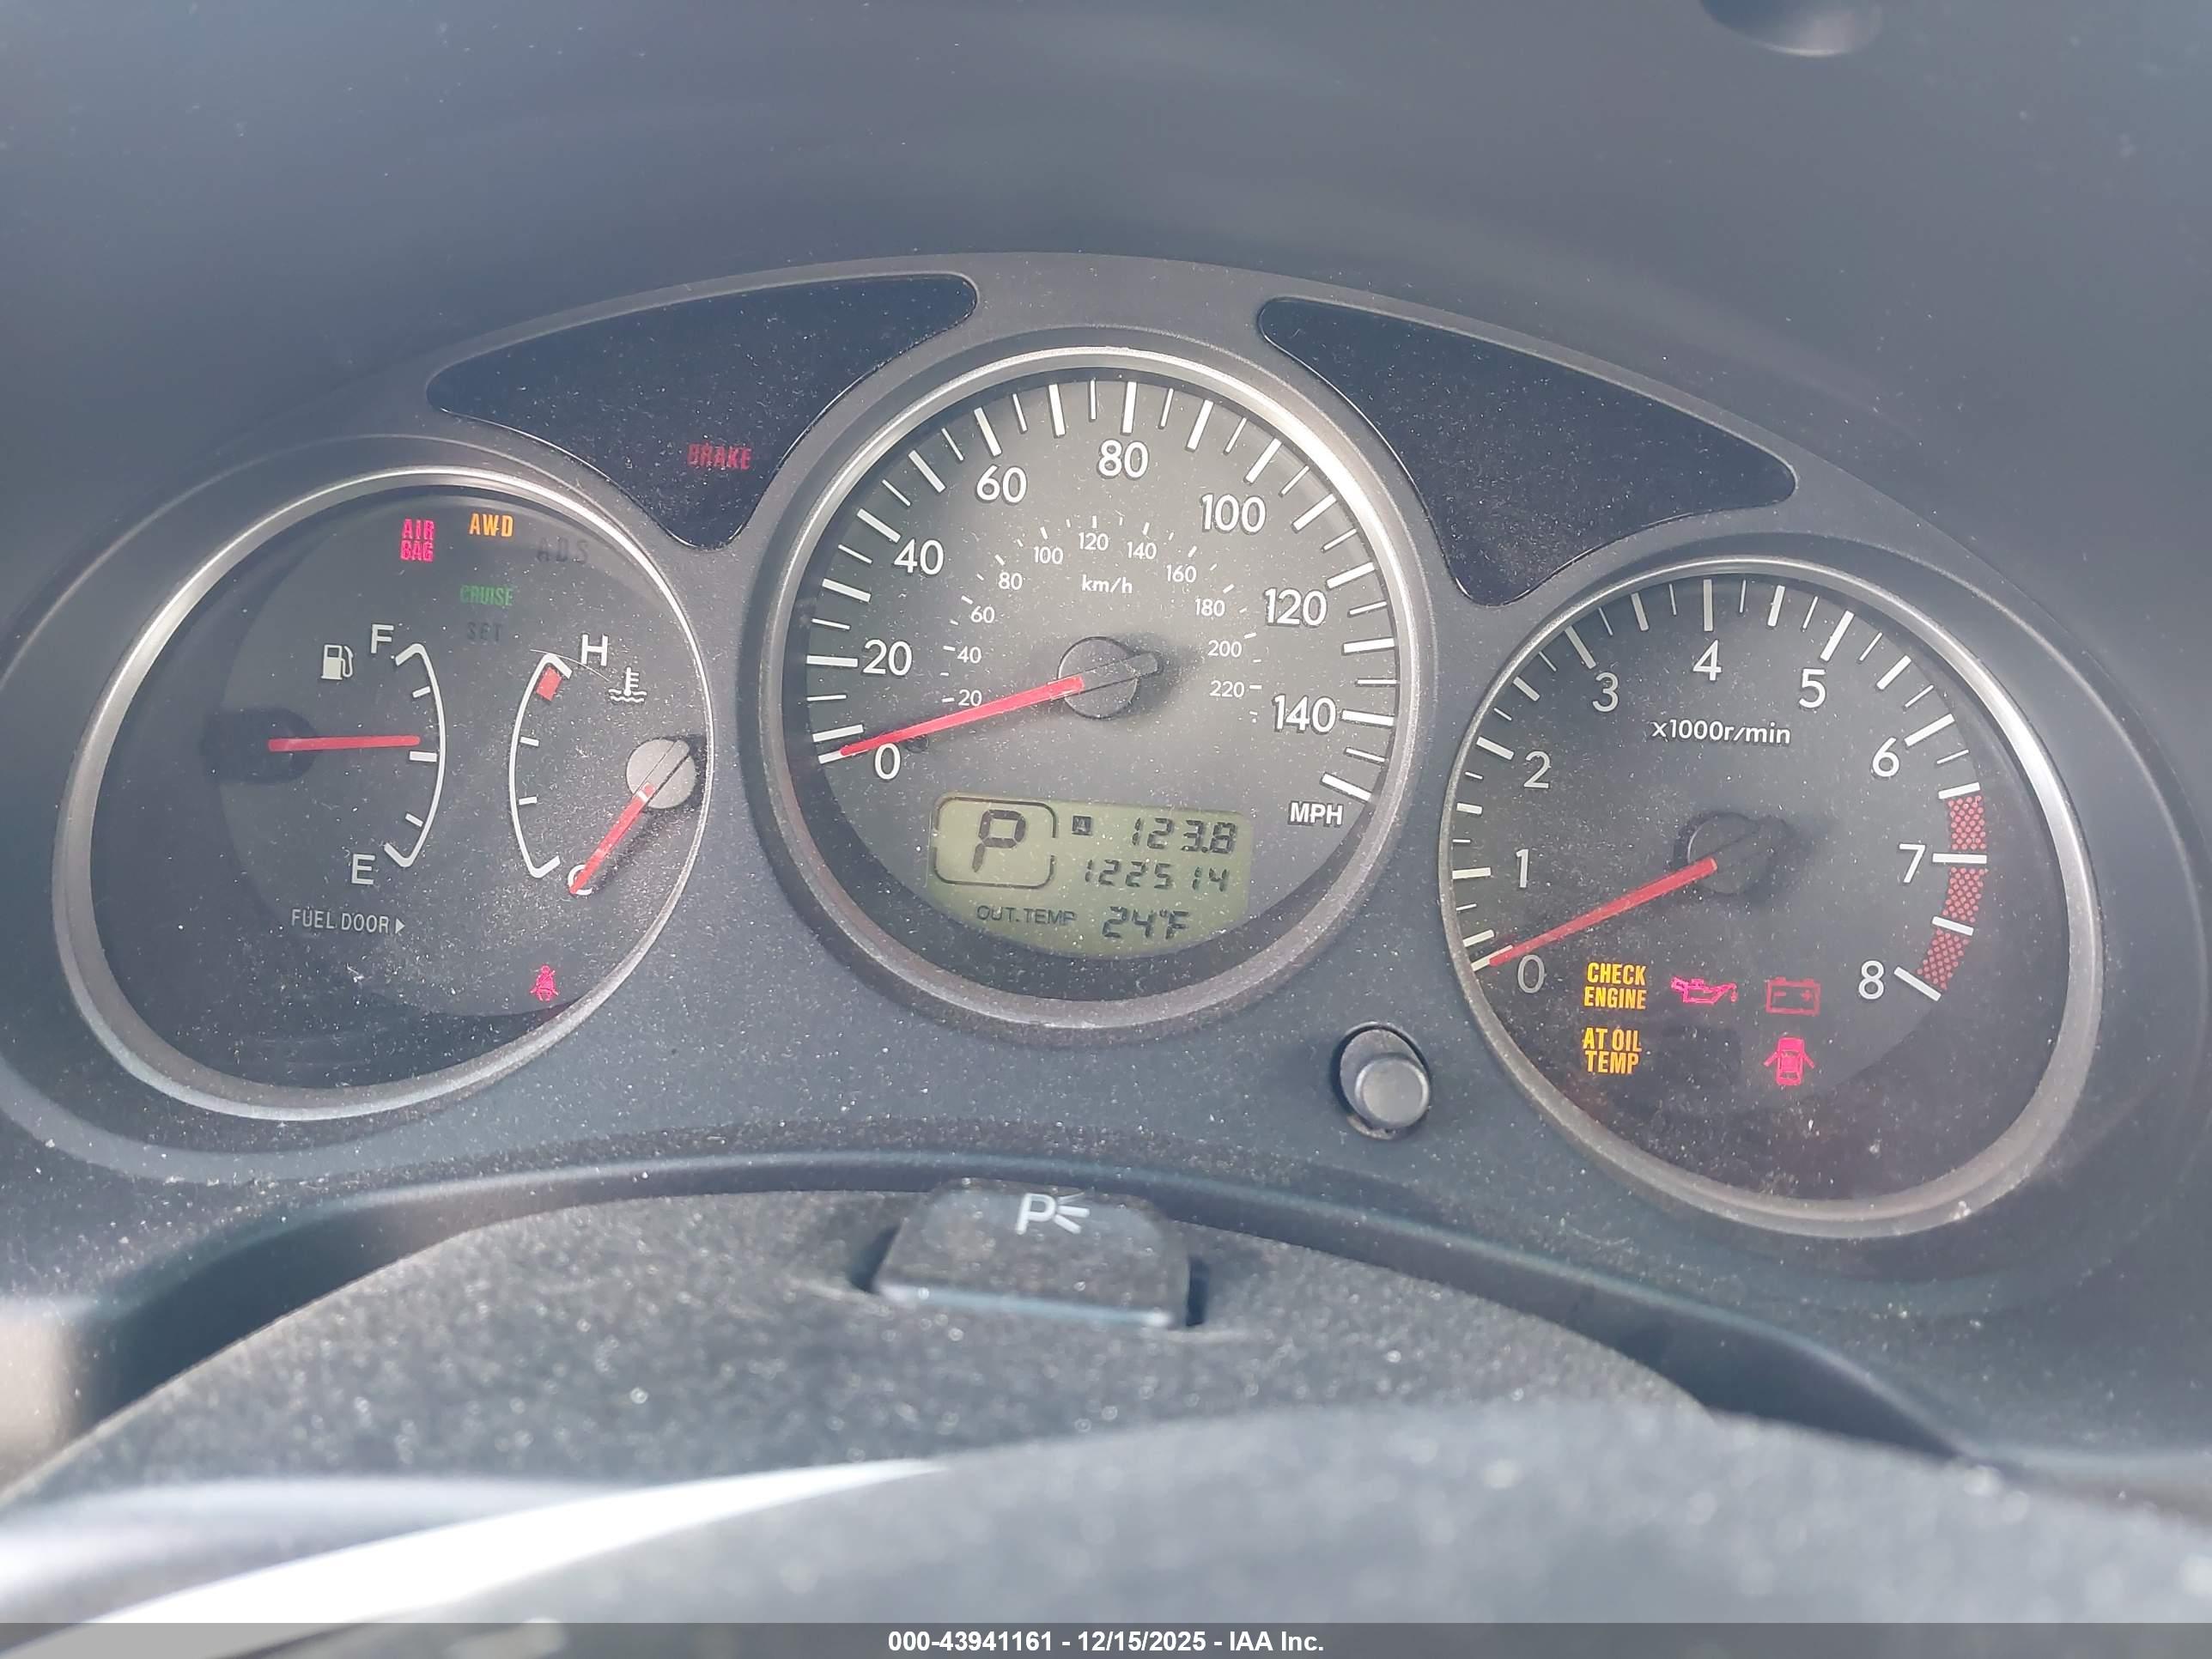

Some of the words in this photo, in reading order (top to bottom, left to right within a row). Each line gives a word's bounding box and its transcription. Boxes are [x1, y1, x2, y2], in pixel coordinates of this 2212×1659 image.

[687, 443, 752, 471] BRAKE
[1097, 441, 1149, 477] 80
[975, 466, 1027, 504] 60
[469, 513, 514, 538] AWD
[1200, 494, 1266, 534] 100
[401, 519, 435, 539] AIR
[1079, 532, 1109, 552] 120
[399, 539, 434, 562] BAG
[894, 539, 945, 575] 40
[1033, 546, 1064, 567] 100
[1127, 542, 1158, 561] 140
[998, 572, 1023, 591] 80
[1081, 574, 1133, 595] km/h
[1166, 564, 1197, 584] 160
[459, 584, 515, 607] CRUISE
[1195, 599, 1225, 618] 180
[1265, 588, 1327, 628] 120
[970, 604, 995, 623] 60
[371, 623, 394, 654] F
[580, 634, 609, 666] H
[1207, 640, 1243, 658] 200
[862, 639, 913, 677] 20
[957, 646, 982, 665] 40
[1692, 640, 1723, 682] 4
[958, 690, 982, 708] 20
[1210, 680, 1245, 699] 220
[1592, 672, 1619, 712] 3
[1799, 668, 1826, 708] 5
[1273, 695, 1337, 734] 140
[1651, 718, 1791, 745] x1000r/min
[874, 743, 901, 781] 0
[1523, 750, 1551, 789] 2
[1872, 736, 1900, 777] 6
[1290, 802, 1343, 826] MPH
[972, 808, 1027, 873] P
[1132, 817, 1237, 854] 123.8
[350, 854, 376, 885] E
[1085, 859, 1231, 892] 122514
[1516, 848, 1529, 888] 1
[1899, 842, 1926, 884] 7
[567, 863, 593, 896] C
[291, 908, 337, 930] FUEL
[341, 910, 391, 934] DOOR
[1516, 954, 1546, 994] 0
[1587, 962, 1647, 987] CHECK
[1858, 959, 1886, 1000] 8
[1583, 986, 1646, 1011] ENGINE
[1583, 1028, 1608, 1051] AT
[1613, 1030, 1642, 1053] OIL
[1586, 1051, 1639, 1075] TEMP
